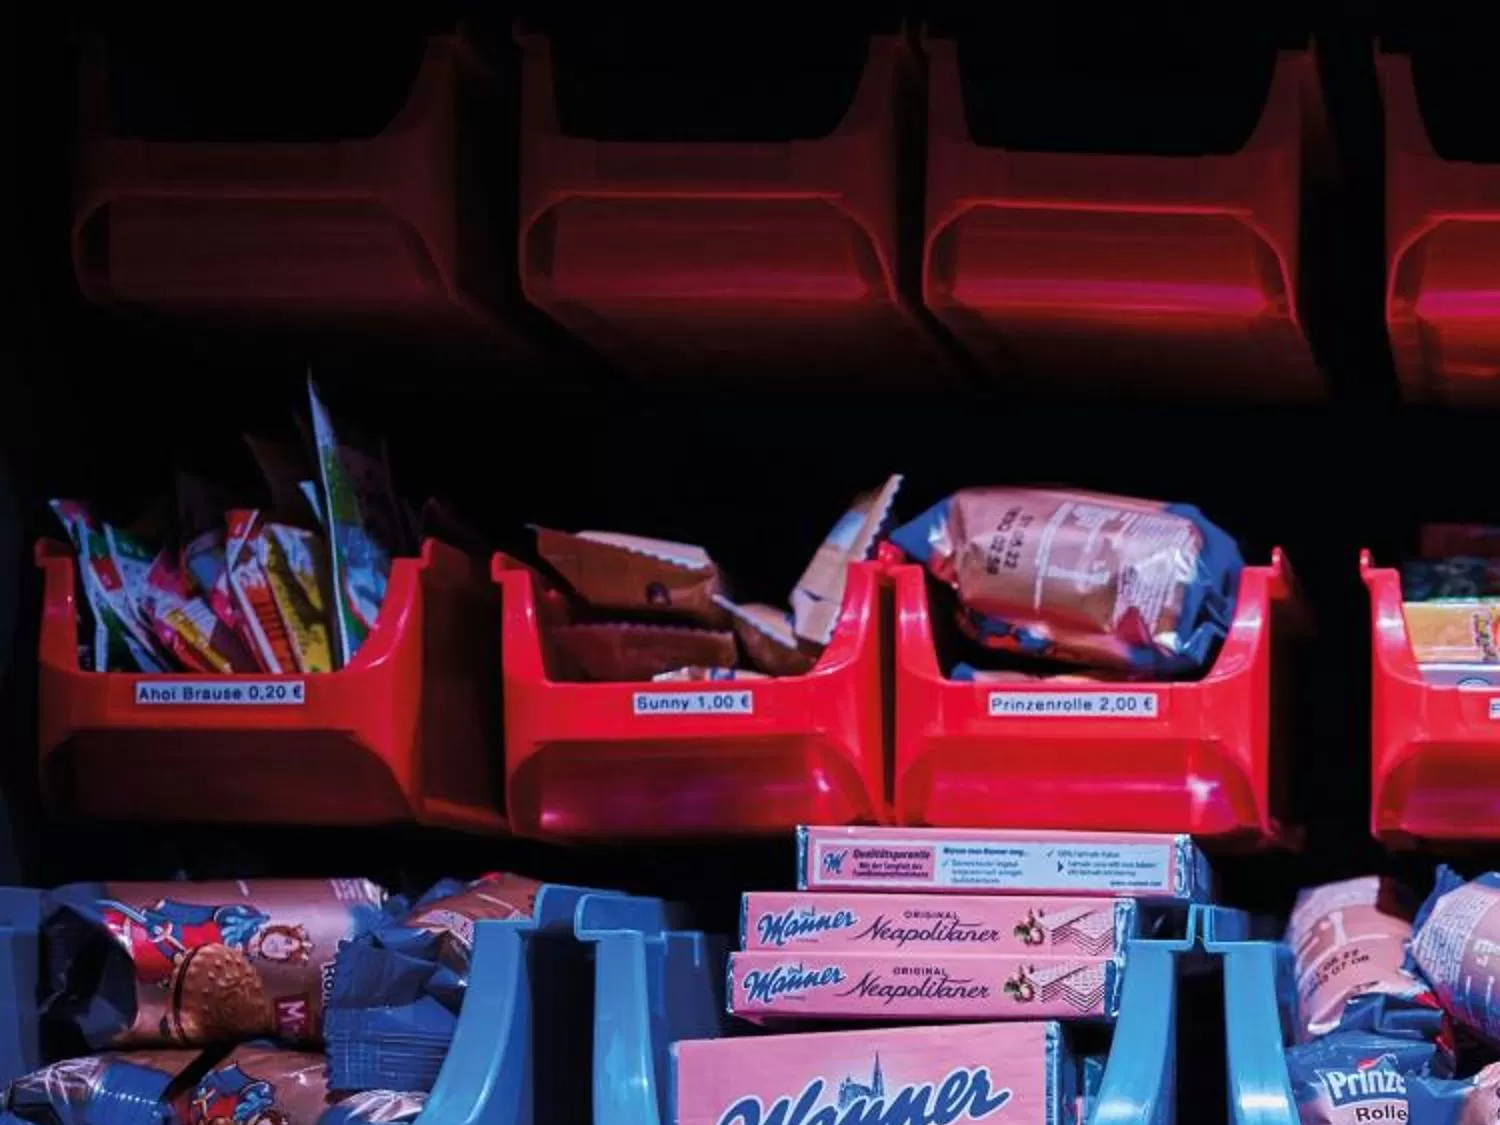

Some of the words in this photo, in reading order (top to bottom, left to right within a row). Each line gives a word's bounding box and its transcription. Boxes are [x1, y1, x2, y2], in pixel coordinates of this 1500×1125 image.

[139, 686, 177, 701] Ahoi
[183, 686, 242, 701] Brause
[249, 685, 287, 701] 0,20
[293, 684, 303, 700] €
[637, 695, 690, 711] Sunny
[697, 694, 734, 711] 1,00
[741, 694, 749, 709] €
[991, 697, 1093, 712] Prinzenrolle
[1099, 696, 1137, 713] 2,00
[1143, 696, 1153, 711] €
[904, 911, 958, 919] ORIGINAL
[757, 908, 858, 946] Manner
[850, 914, 1001, 952] Neapolitaner
[893, 967, 947, 975] ORIGINAL
[743, 966, 845, 1004] Manner
[834, 972, 990, 1005] Neapolitaner
[1355, 1104, 1407, 1122] Rolle
